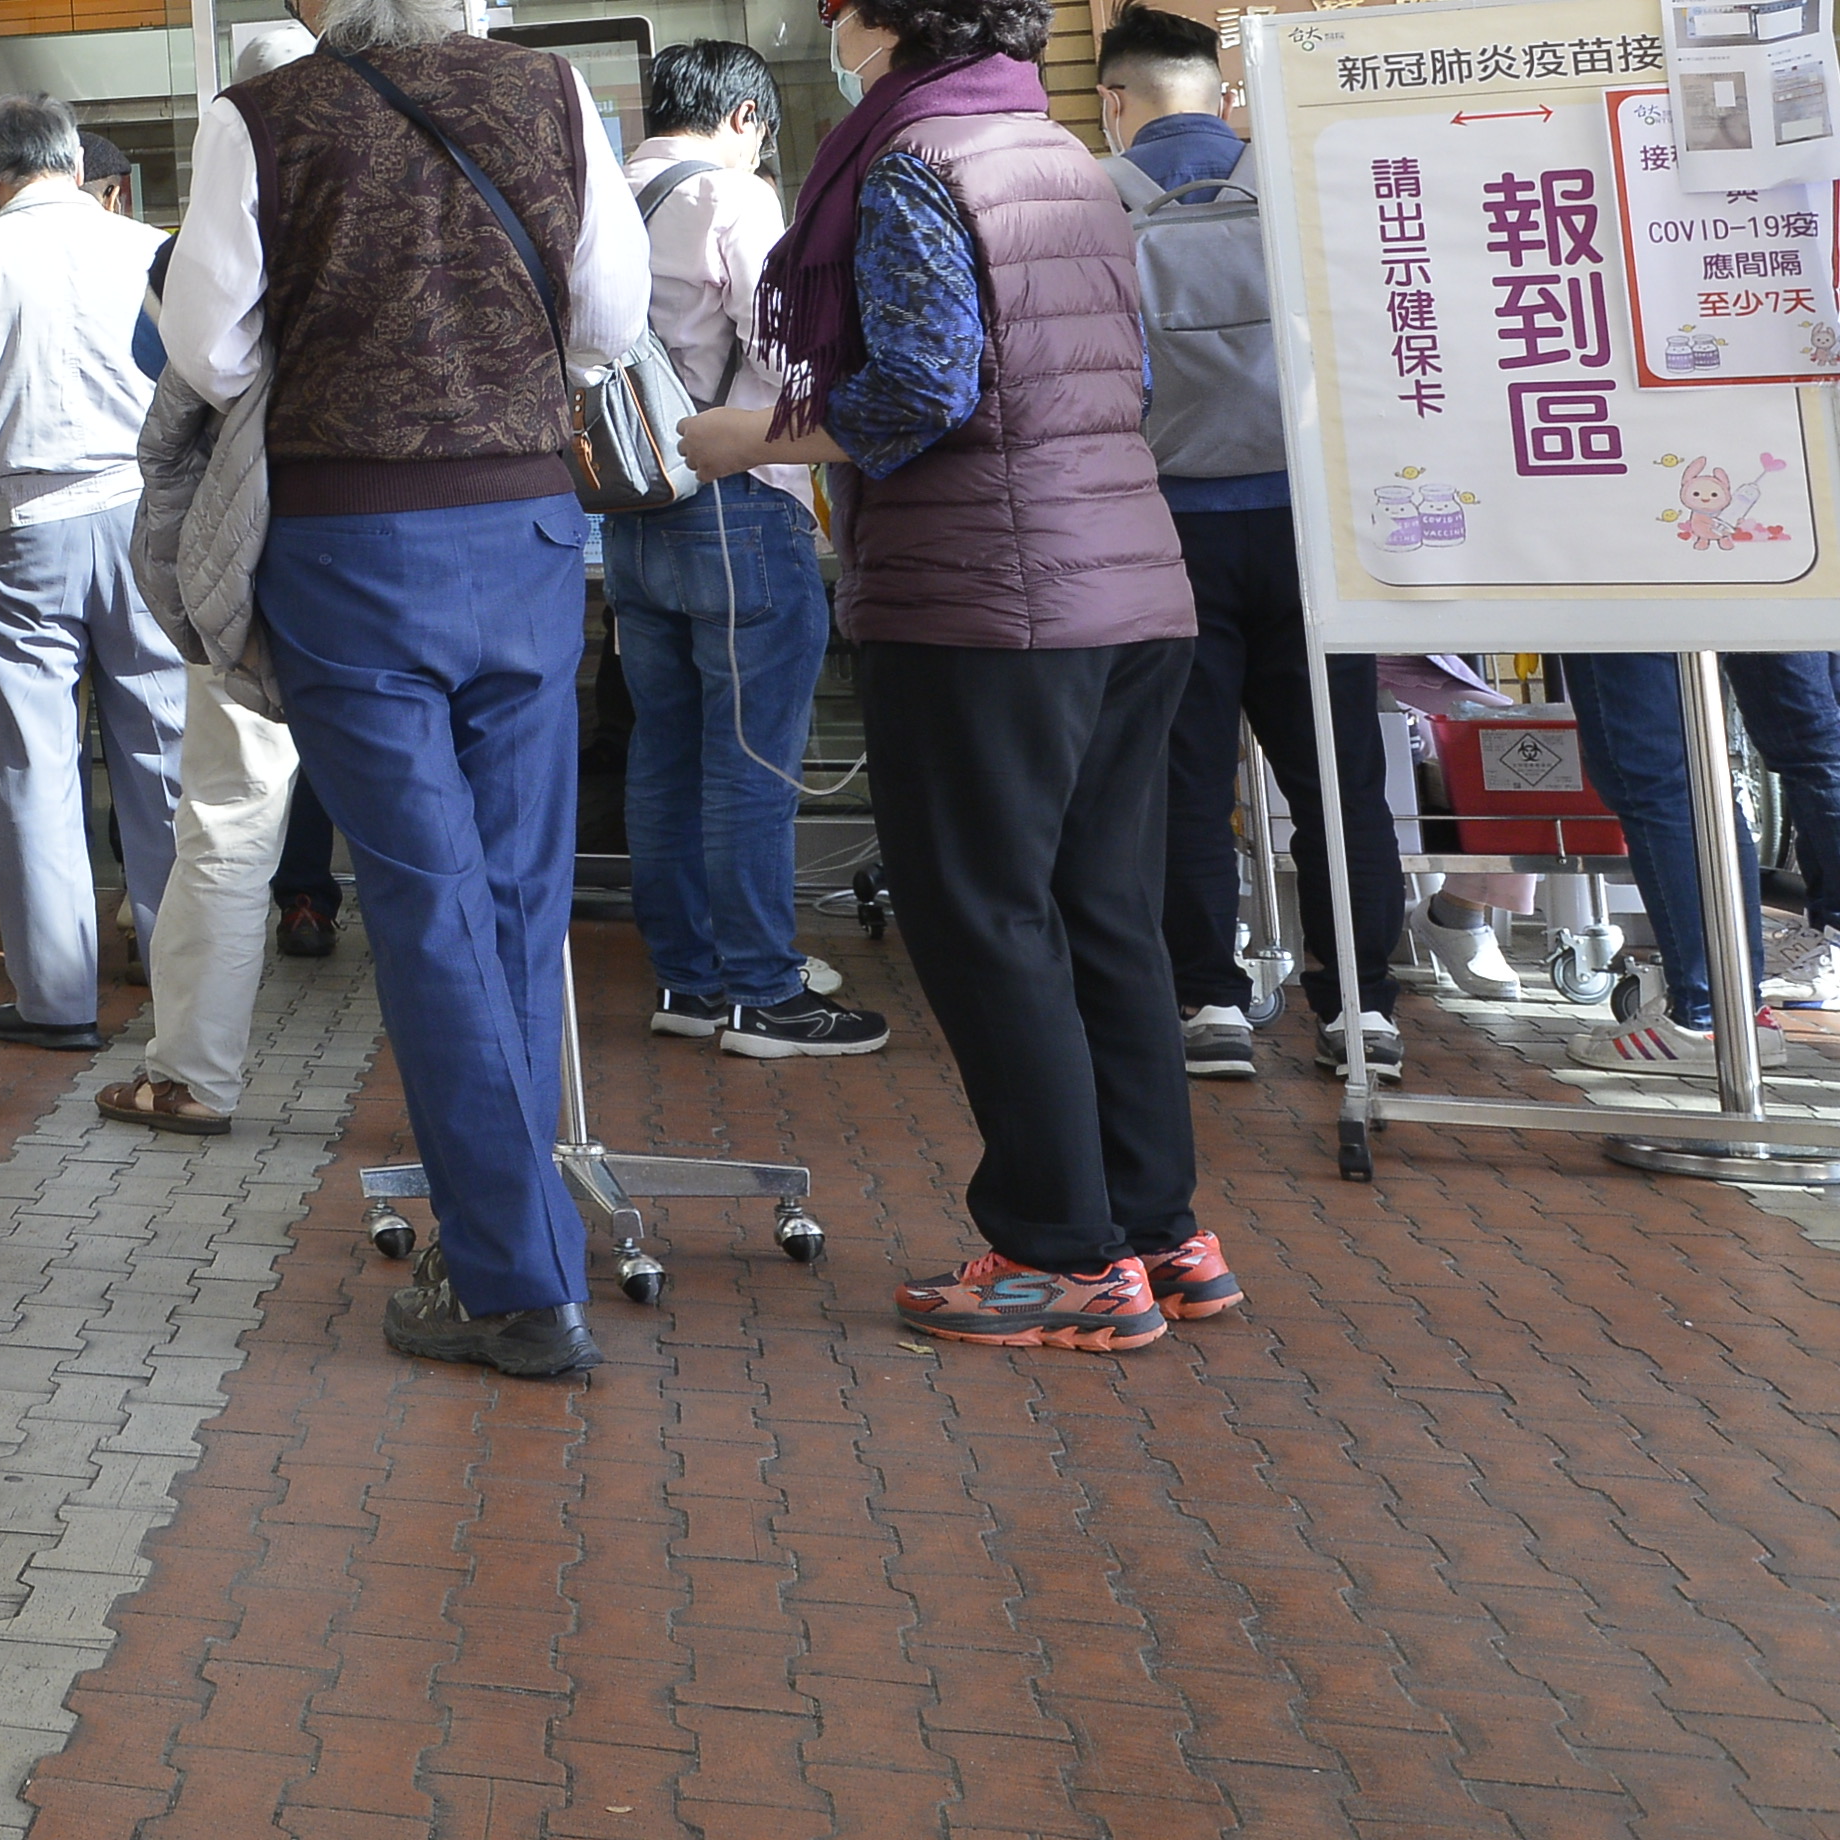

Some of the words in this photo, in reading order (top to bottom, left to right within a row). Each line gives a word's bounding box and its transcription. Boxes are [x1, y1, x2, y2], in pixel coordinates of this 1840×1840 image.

[1337, 32, 1664, 94] 新冠肺炎疫苗接
[1370, 156, 1446, 420] 請出示健保卡
[1702, 249, 1803, 281] 應間隔
[1482, 167, 1630, 478] 報到區
[1697, 288, 1816, 318] 至少7天
